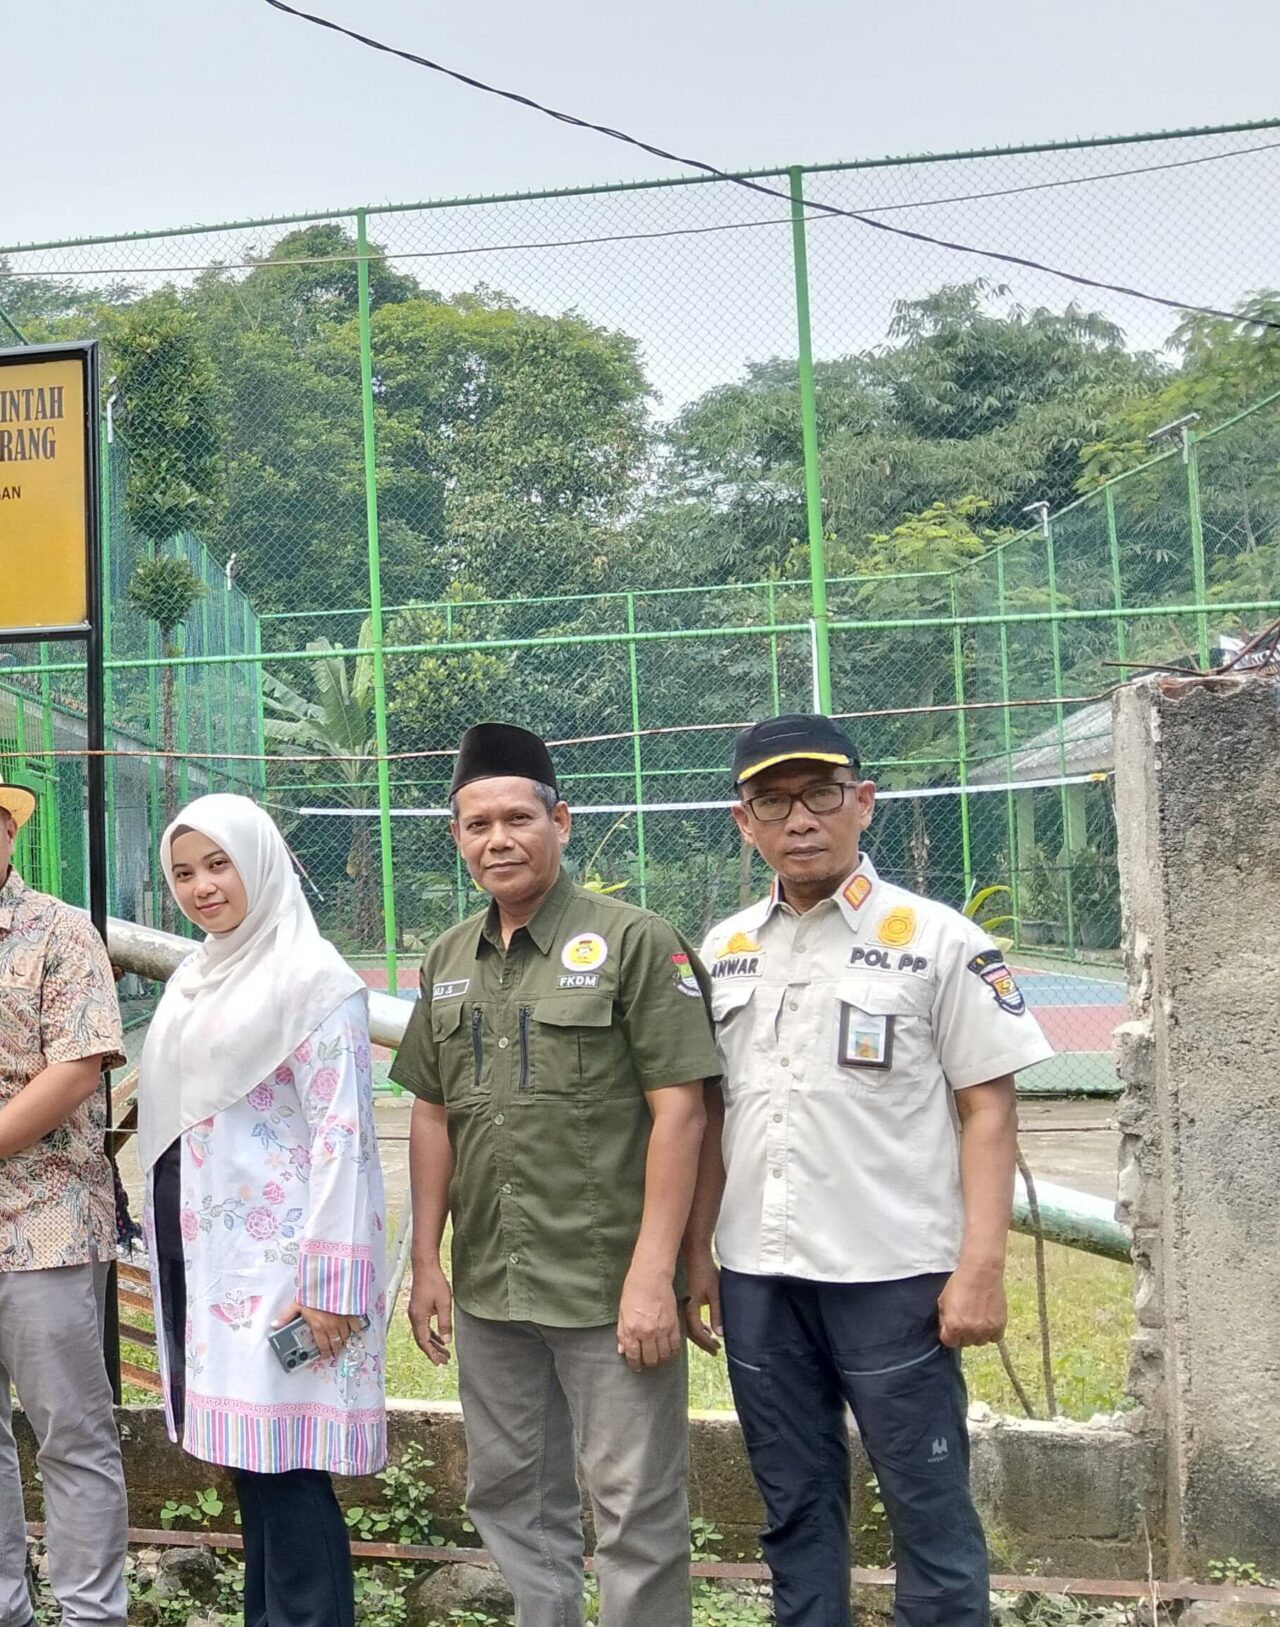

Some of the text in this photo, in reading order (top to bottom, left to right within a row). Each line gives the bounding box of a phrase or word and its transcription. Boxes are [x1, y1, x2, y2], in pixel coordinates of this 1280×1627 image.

[711, 957, 759, 979] ANWAR
[850, 947, 928, 973] POL PP
[559, 975, 597, 987] FKDM
